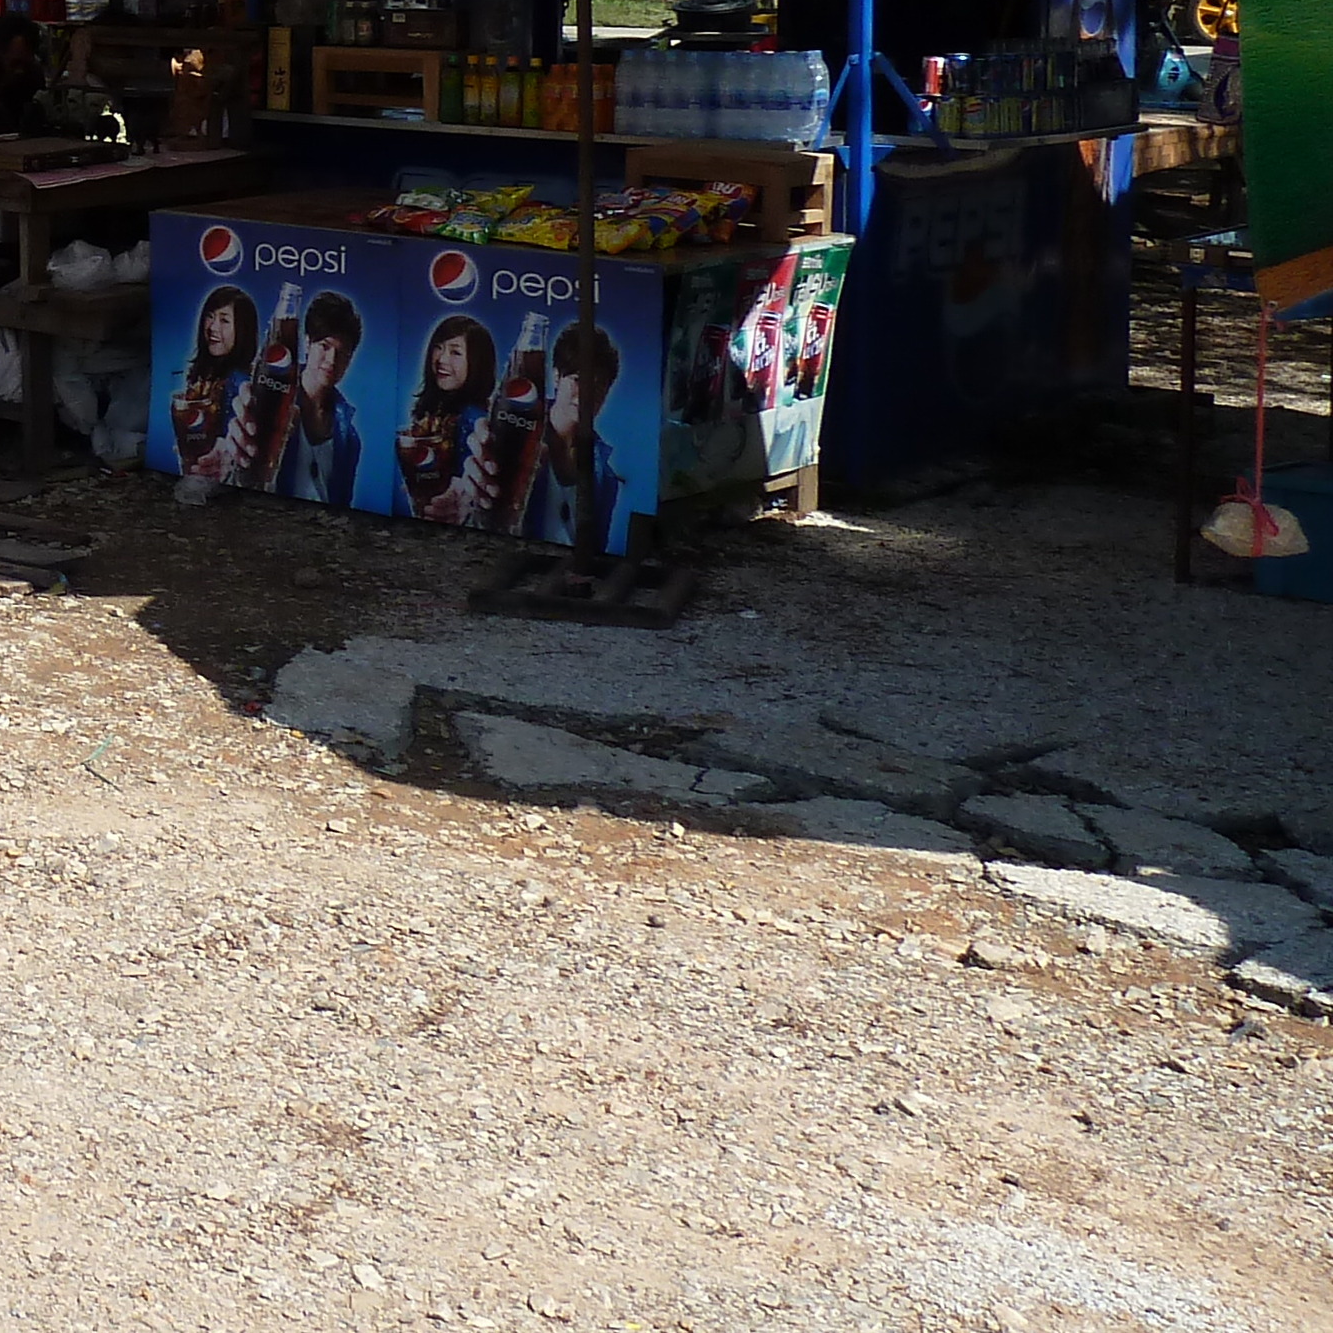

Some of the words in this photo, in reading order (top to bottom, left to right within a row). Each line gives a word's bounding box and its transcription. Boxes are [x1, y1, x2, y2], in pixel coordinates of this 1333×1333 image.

[254, 242, 347, 276] pepsi
[256, 372, 291, 395] pepsi
[496, 408, 538, 432] pepsi
